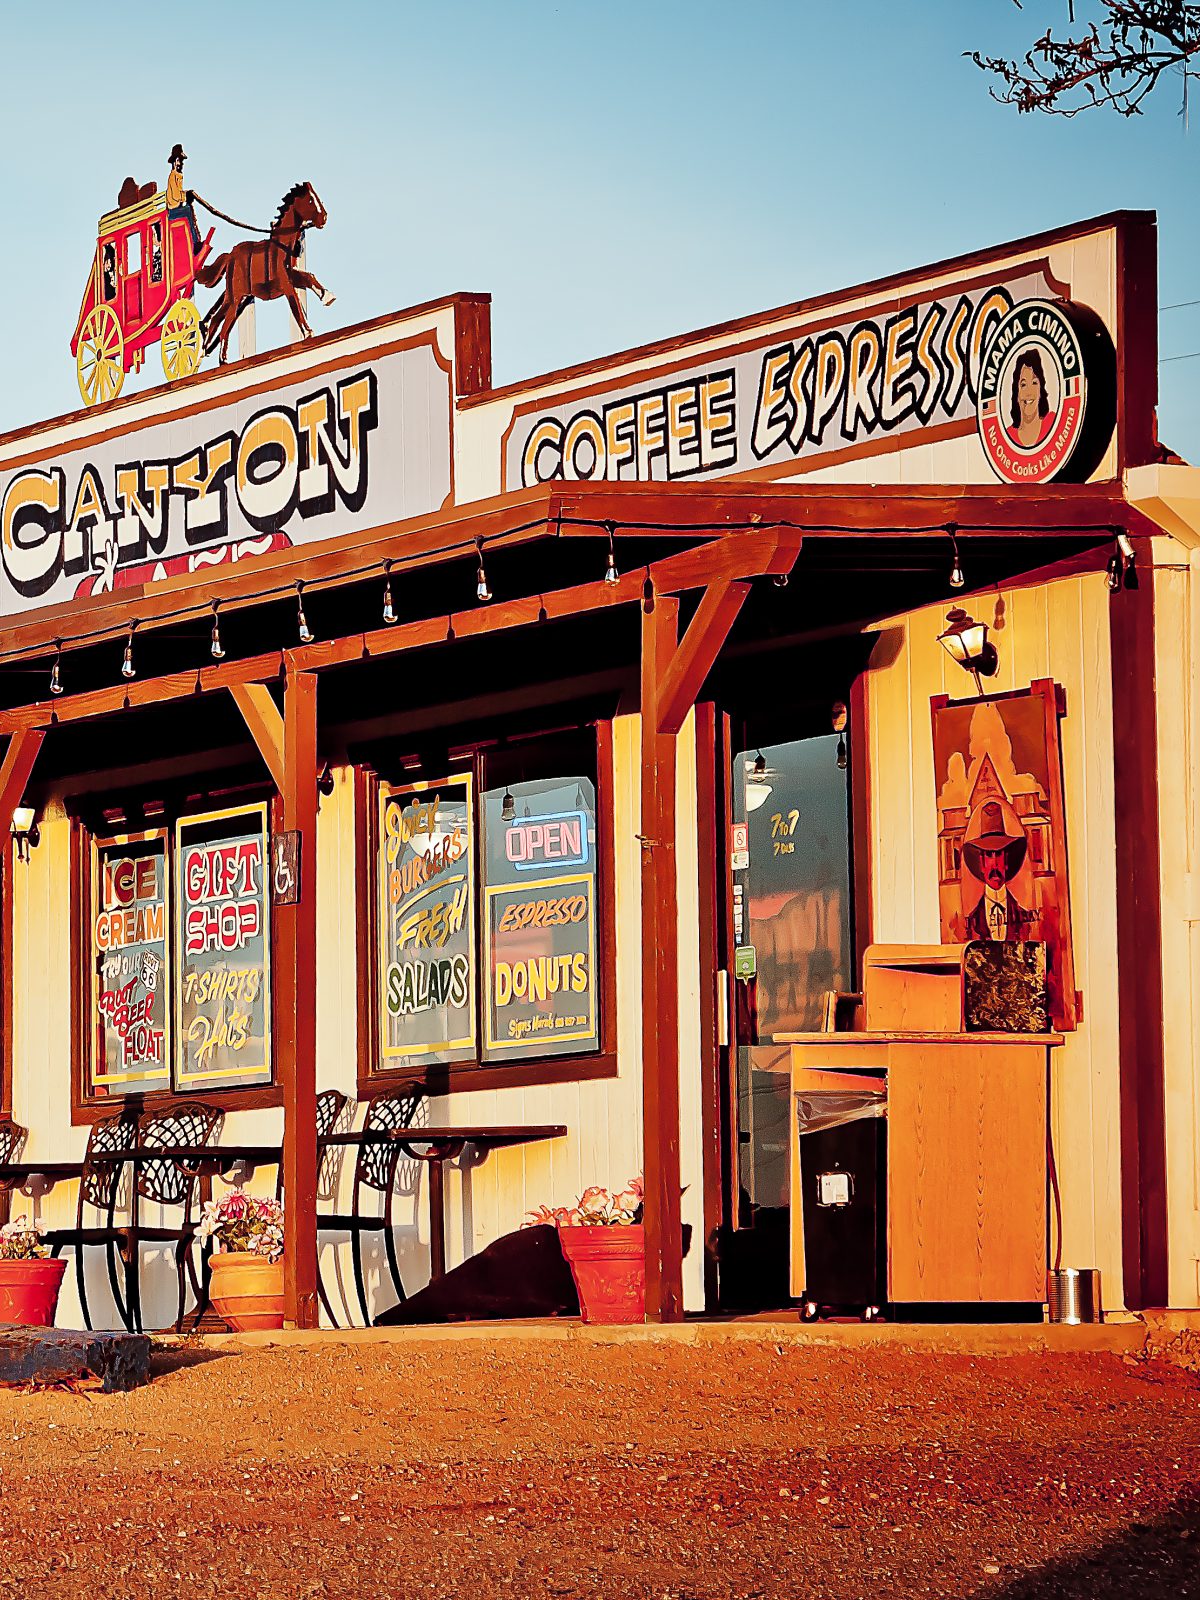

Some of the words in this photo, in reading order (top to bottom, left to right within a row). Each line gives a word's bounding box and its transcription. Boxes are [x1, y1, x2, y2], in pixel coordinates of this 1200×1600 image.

[984, 318, 1024, 391] MAMA
[1028, 311, 1076, 370] CIMINO
[521, 369, 737, 484] COFFEE
[988, 424, 998, 447] No
[996, 447, 1011, 468] One
[1011, 461, 1039, 477] Cooks
[1039, 450, 1057, 472] Like
[1056, 406, 1076, 453] Mama
[1, 369, 378, 598] CANYON
[505, 819, 582, 862] OPEN
[771, 812, 782, 838] 7
[788, 808, 800, 836] 7
[103, 852, 159, 911] ICE
[185, 838, 262, 905] GIFT
[389, 827, 462, 904] BURGERS
[95, 902, 166, 952] CREAM
[185, 899, 261, 958] SHOP
[396, 883, 468, 951] FRESH
[498, 895, 588, 933] ESPRESSO
[101, 953, 121, 981] TRY
[142, 966, 155, 986] 66
[185, 967, 260, 1006] T-SHIRTS
[386, 953, 469, 1018] SALADS
[495, 952, 588, 1008] DONUTS
[112, 991, 155, 1041] BEER
[187, 1007, 248, 1068] Hats
[121, 1025, 163, 1069] FLOAT
